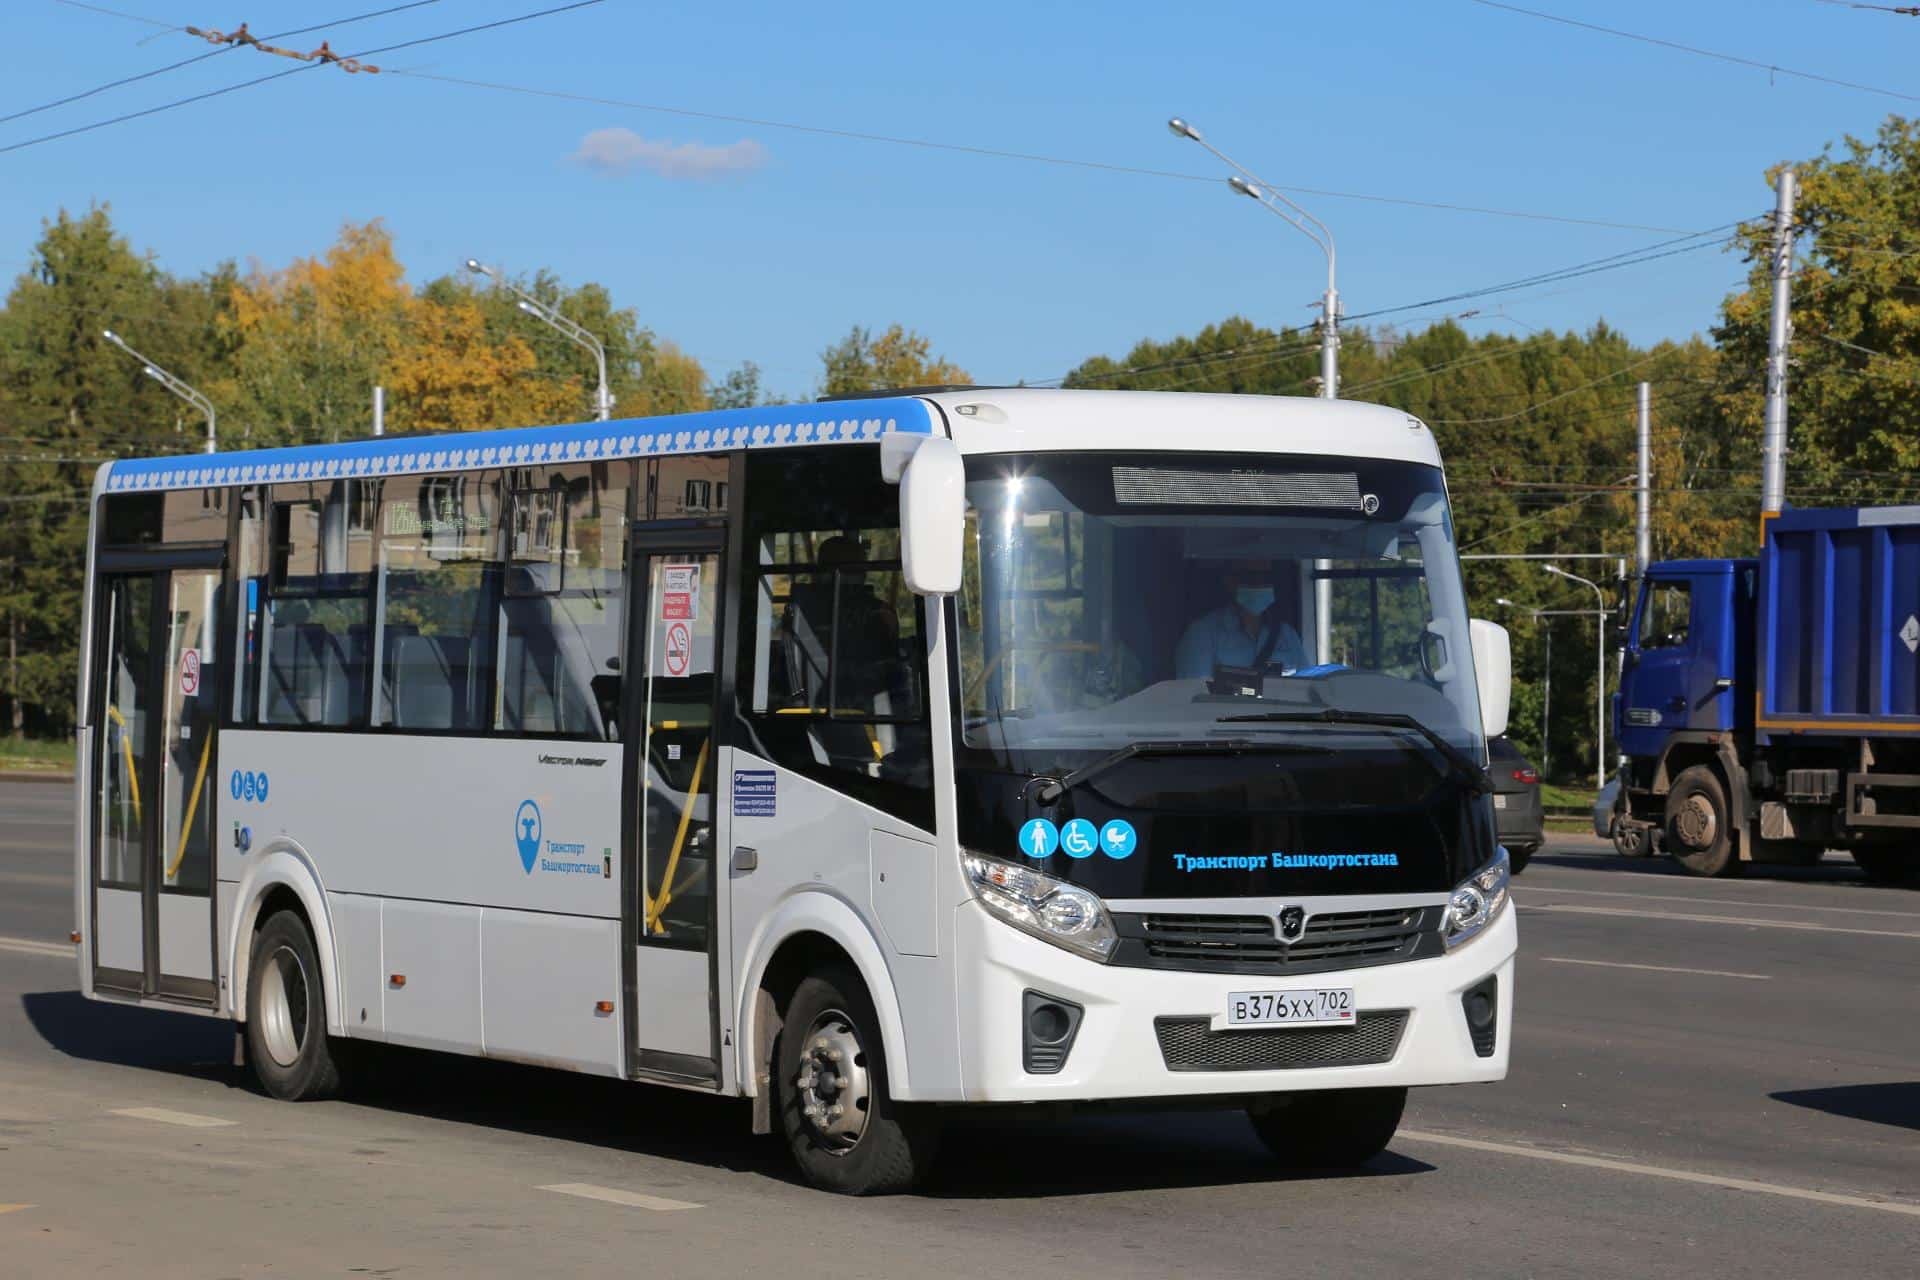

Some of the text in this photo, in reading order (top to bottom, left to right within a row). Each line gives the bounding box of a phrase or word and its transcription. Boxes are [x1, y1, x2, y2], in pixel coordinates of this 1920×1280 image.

[546, 840, 585, 856] Транспорт
[541, 858, 601, 874] Башкортостана
[1173, 852, 1399, 872] Транспорт Башкортостана
[1318, 991, 1349, 1010] 702
